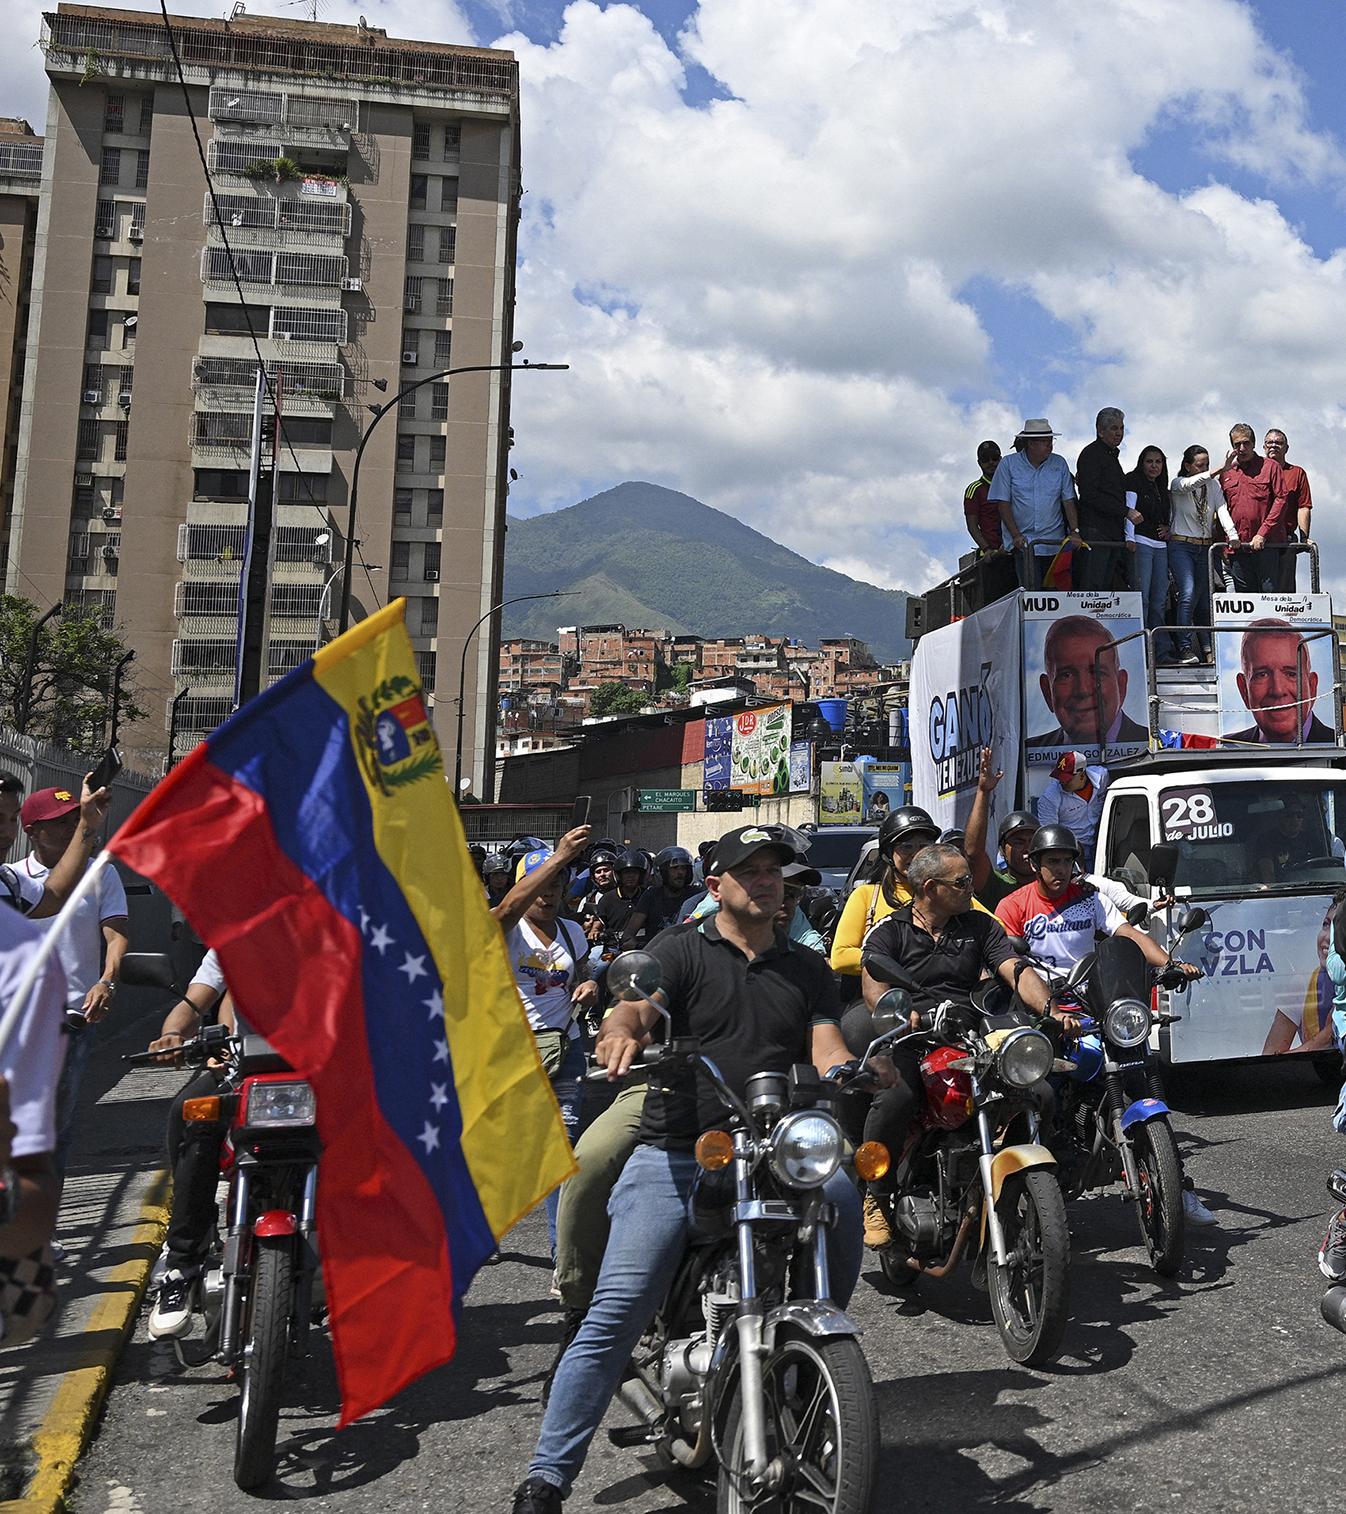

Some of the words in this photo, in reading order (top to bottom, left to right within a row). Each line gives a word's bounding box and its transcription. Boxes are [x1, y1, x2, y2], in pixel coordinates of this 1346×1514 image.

[1022, 597, 1060, 612] MUD
[1080, 600, 1112, 609] Unidad
[1215, 600, 1255, 614] MUD
[1274, 604, 1305, 613] Unidad
[931, 662, 992, 763] GANÓ
[739, 714, 754, 732] JDR
[1083, 747, 1140, 759] GOZÁLEZ
[937, 747, 981, 793] VENEZUE
[1162, 794, 1214, 829] 28
[1165, 830, 1184, 842] de
[1187, 822, 1233, 841] JULIO
[1204, 928, 1266, 954] CON
[1200, 952, 1275, 977] VZLA
